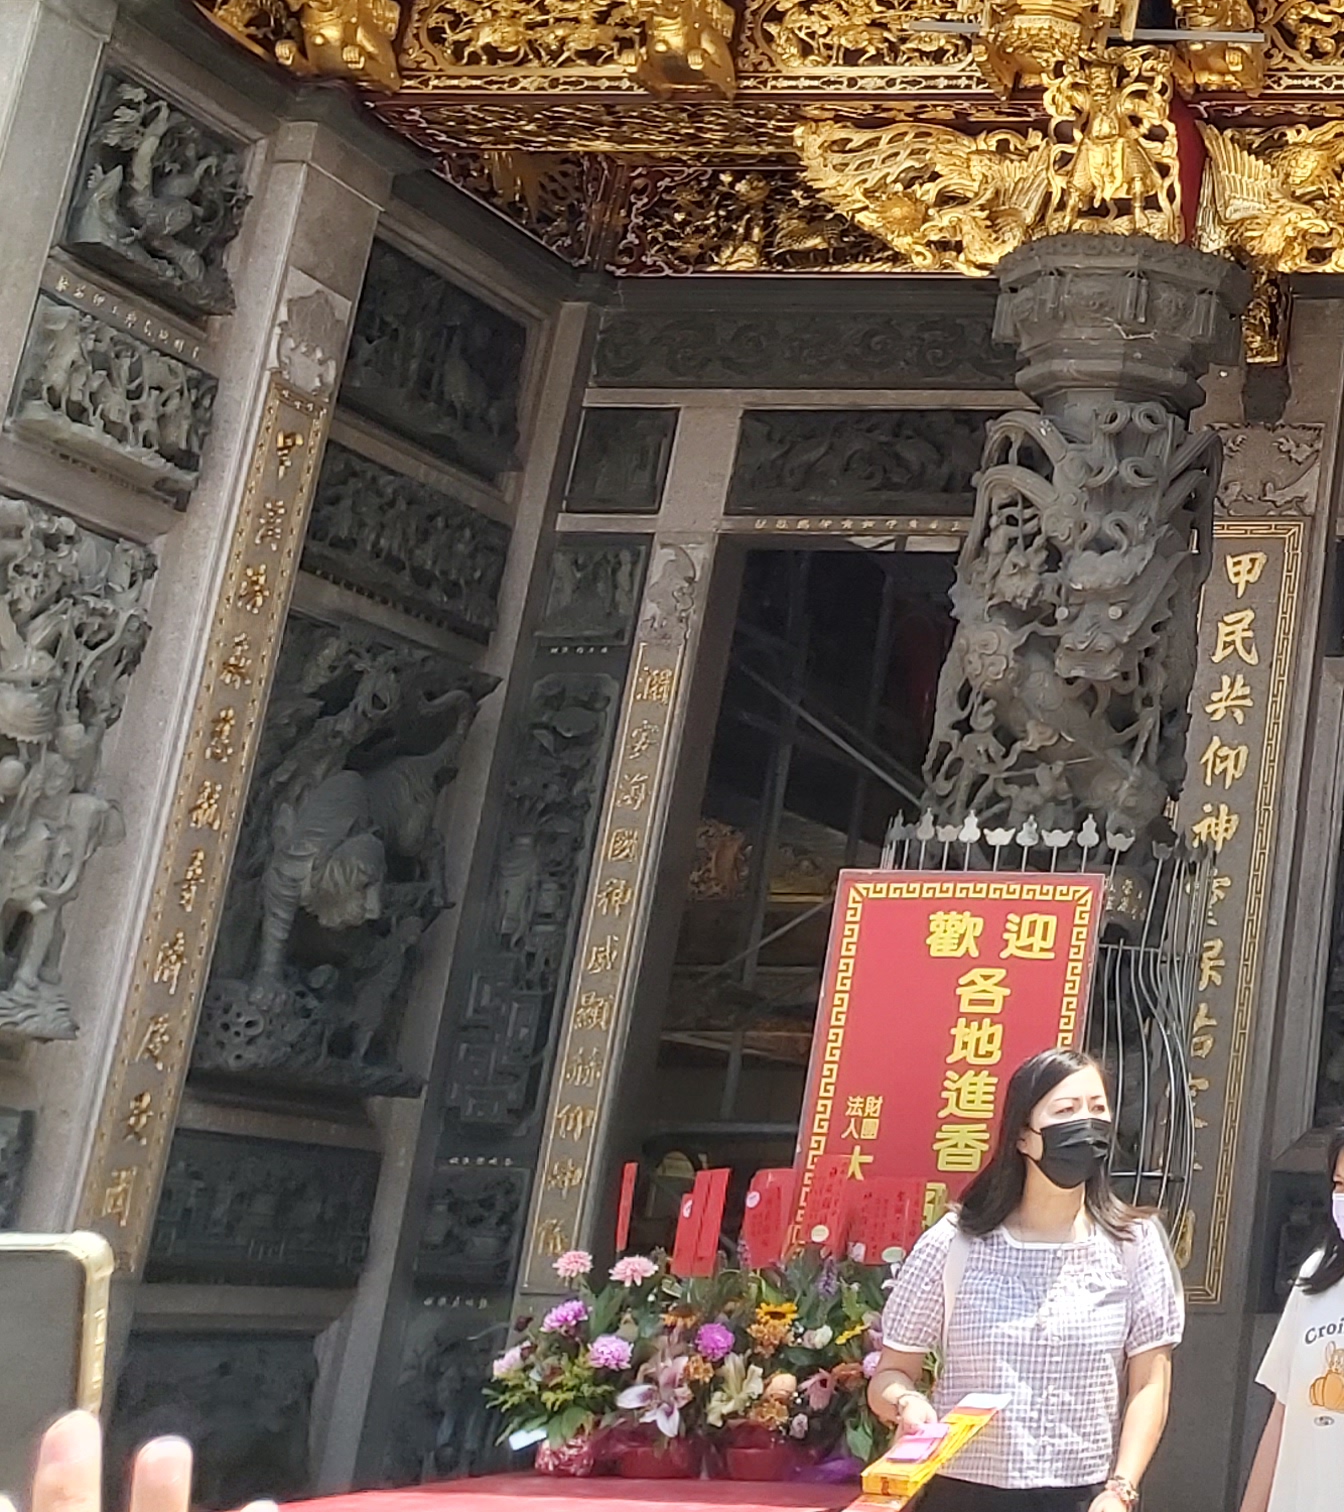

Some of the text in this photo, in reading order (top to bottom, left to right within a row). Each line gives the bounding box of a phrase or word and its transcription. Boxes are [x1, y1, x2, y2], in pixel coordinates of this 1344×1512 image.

[925, 911, 1058, 960] 歡迎
[922, 967, 1011, 1230] 各地進香
